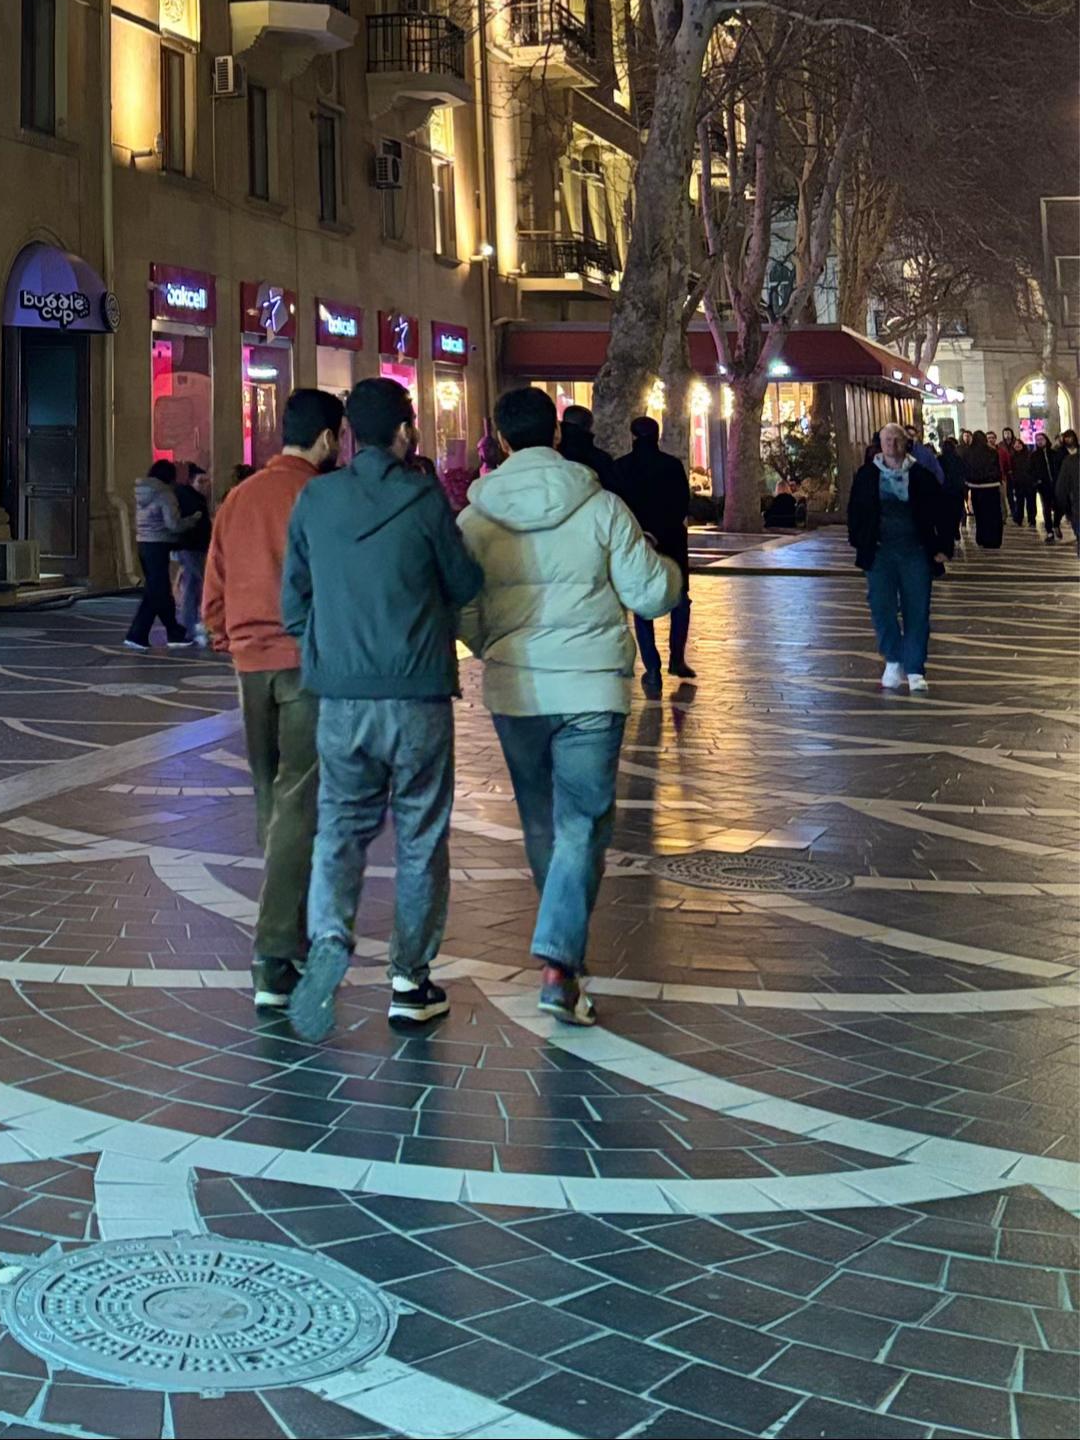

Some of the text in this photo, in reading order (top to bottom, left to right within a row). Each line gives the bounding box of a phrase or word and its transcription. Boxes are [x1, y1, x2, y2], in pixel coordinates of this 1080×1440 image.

[23, 291, 84, 310] bubble
[167, 283, 207, 310] bakcell
[42, 307, 74, 325] cup
